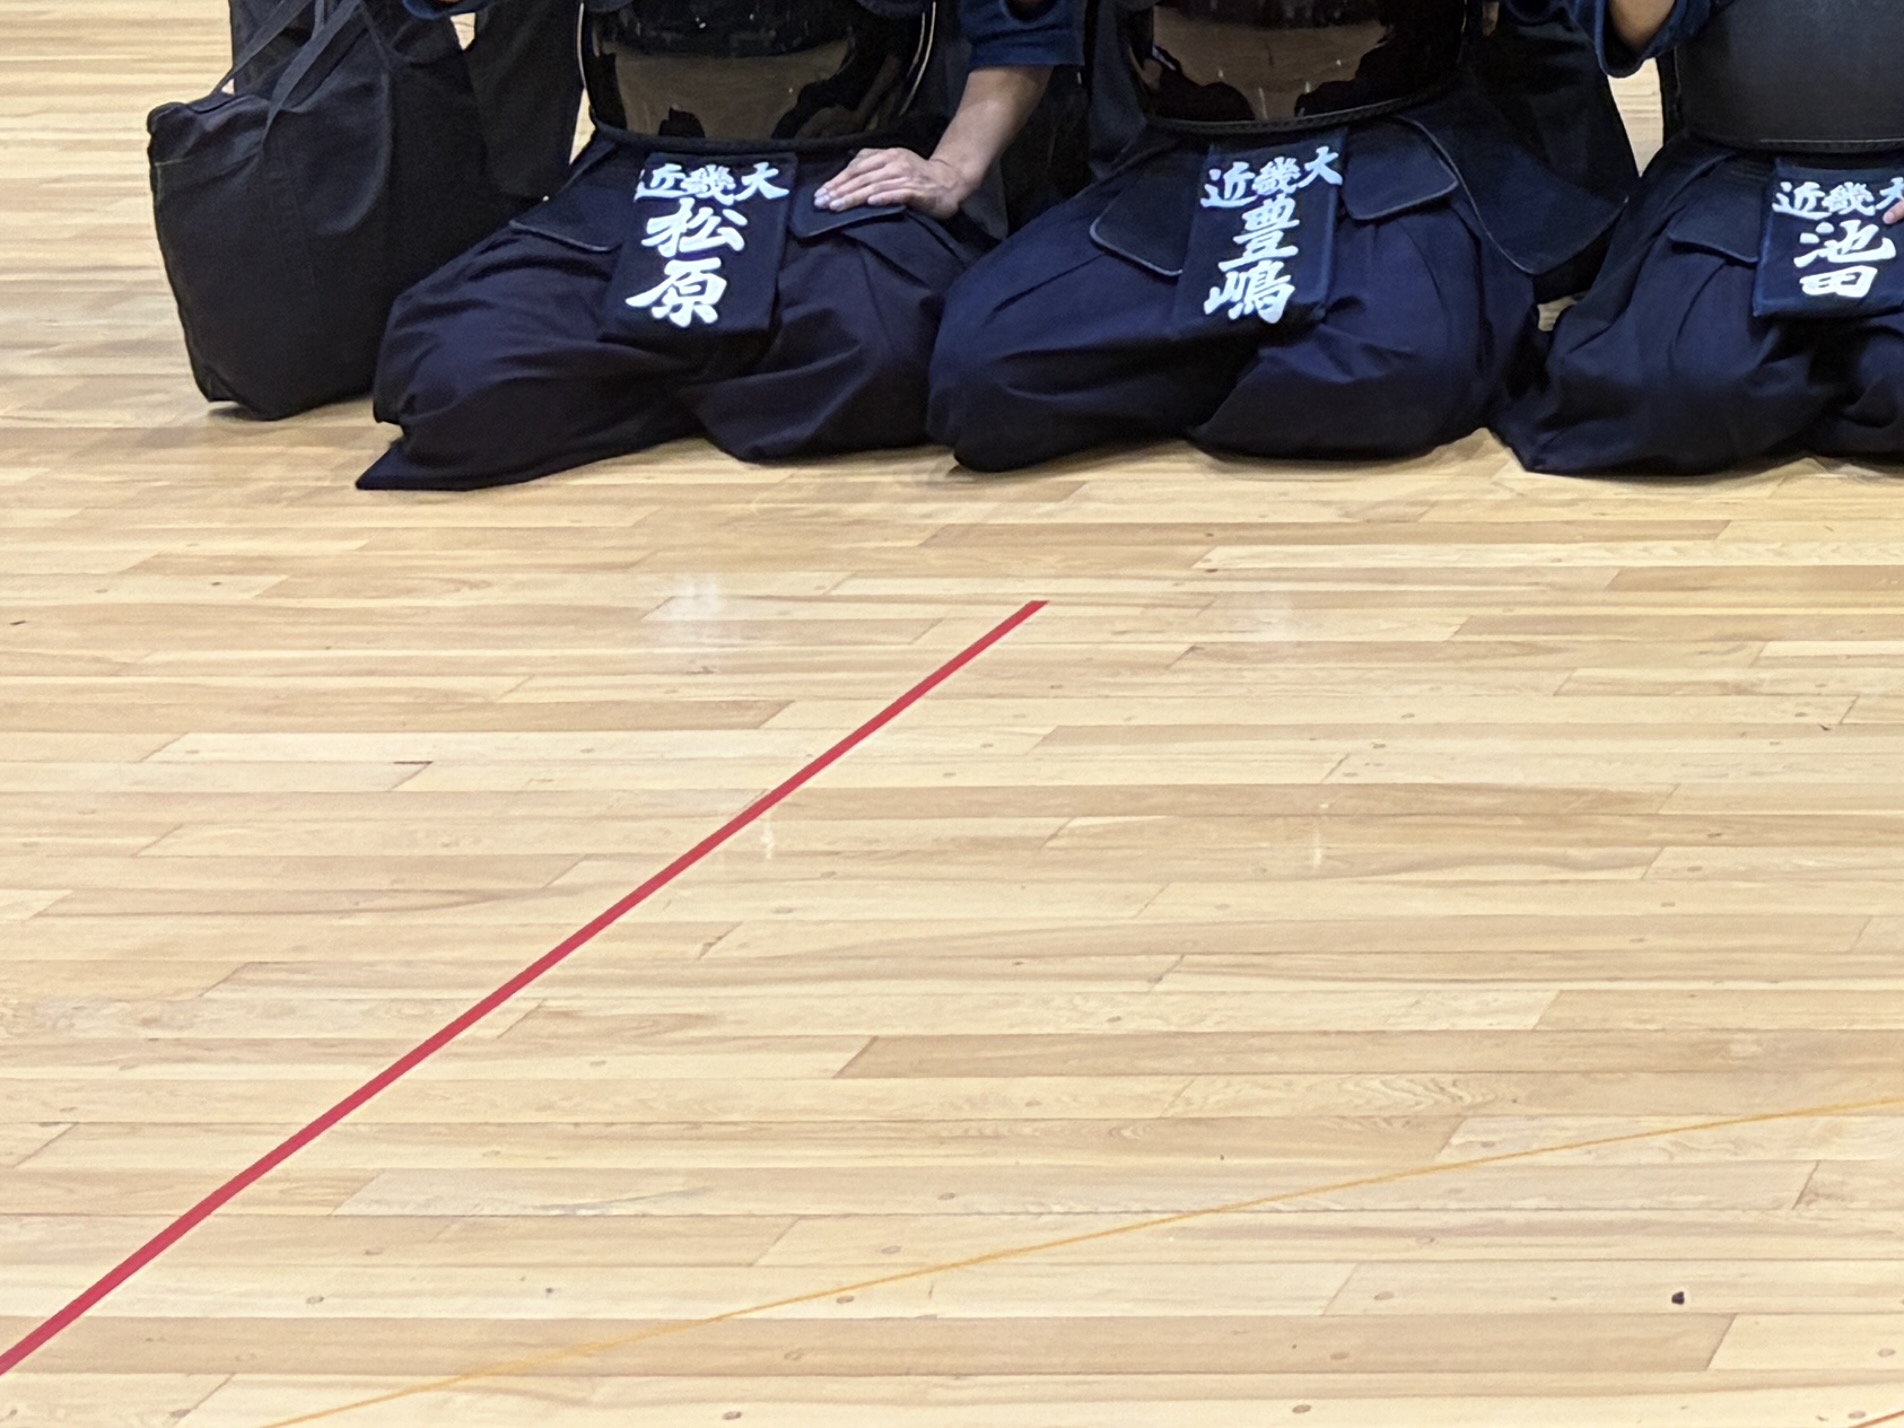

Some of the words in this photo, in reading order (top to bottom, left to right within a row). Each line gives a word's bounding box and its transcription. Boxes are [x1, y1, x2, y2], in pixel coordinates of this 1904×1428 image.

[633, 161, 790, 206] 近畿大
[1200, 146, 1343, 208] 近畿大
[625, 197, 748, 328] 松原
[1793, 219, 1897, 298] 池田
